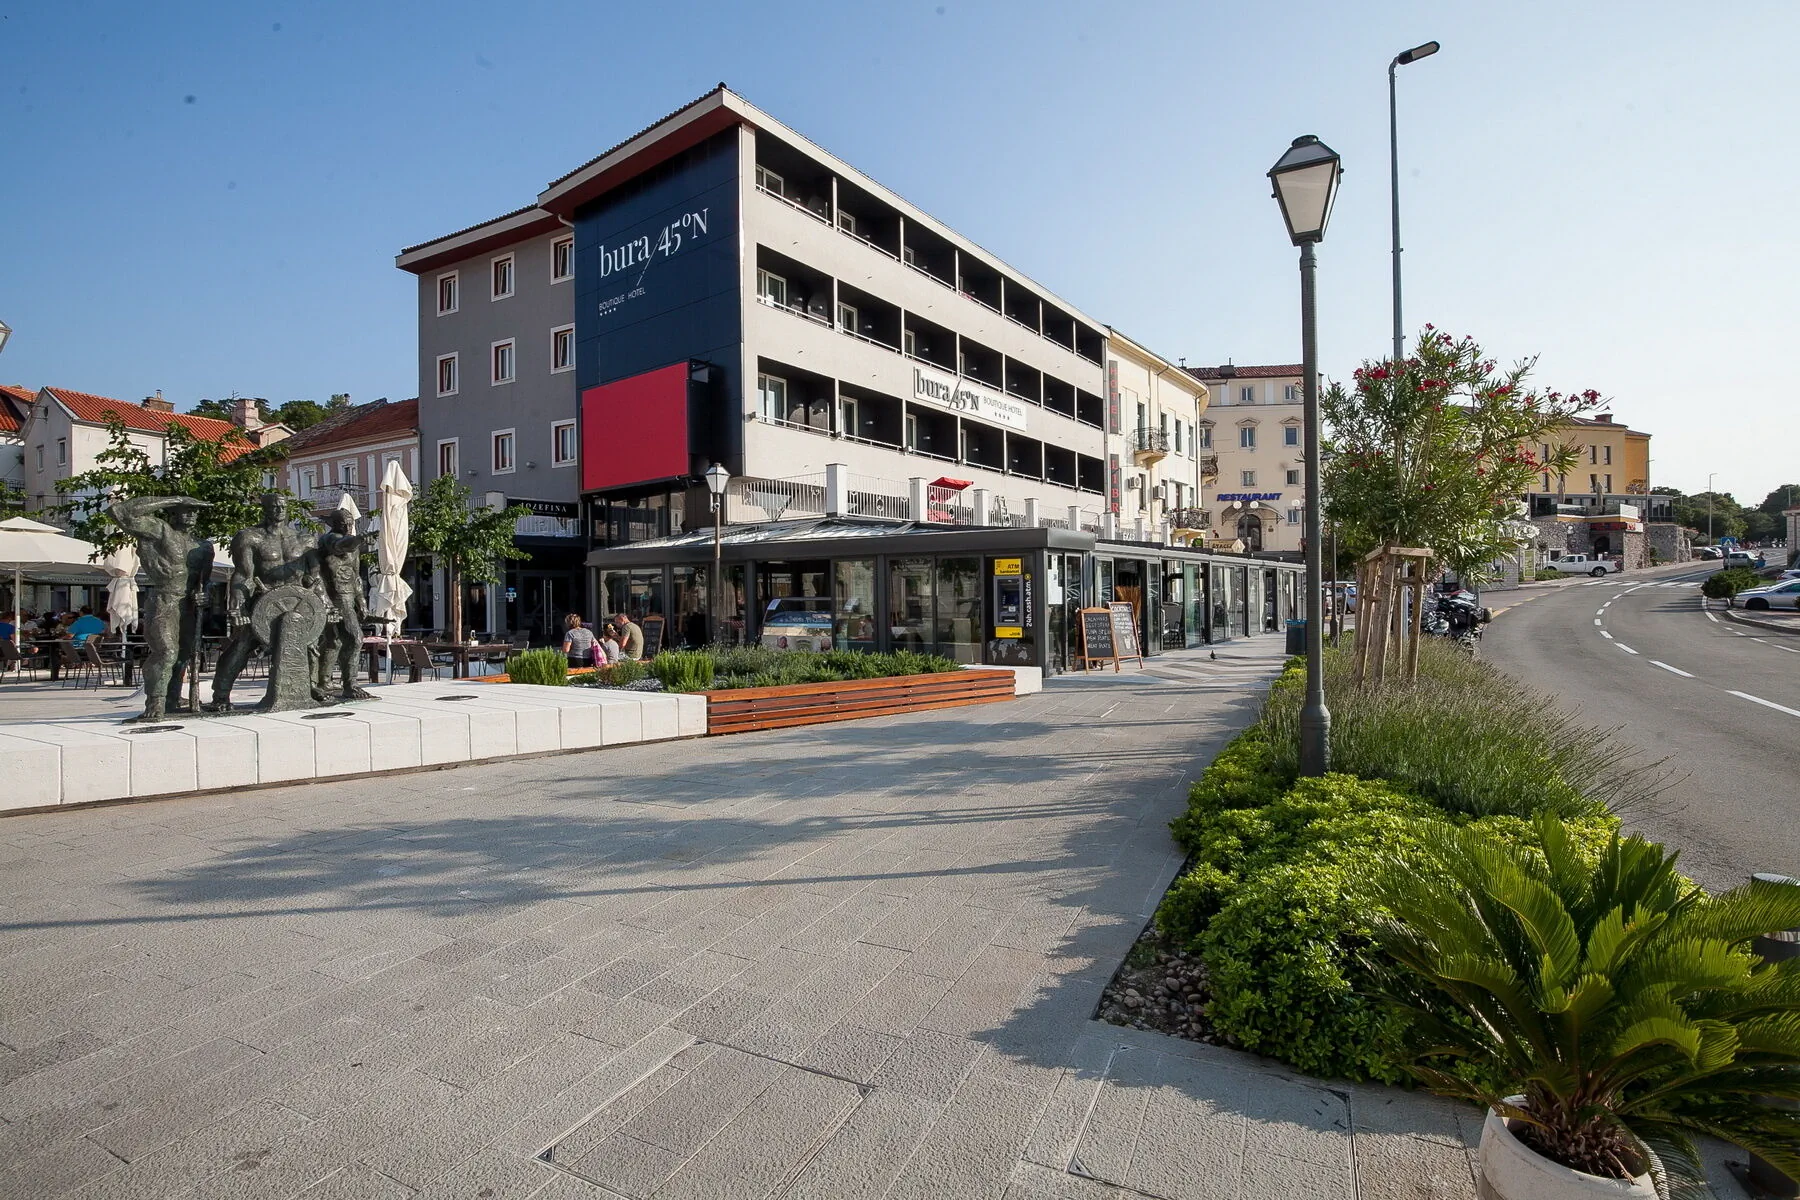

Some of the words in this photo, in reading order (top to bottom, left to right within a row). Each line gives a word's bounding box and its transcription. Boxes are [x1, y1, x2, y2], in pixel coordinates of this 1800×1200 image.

[599, 235, 650, 279] bura
[598, 294, 625, 311] BOUTIQUE
[627, 287, 646, 299] HOTEL
[915, 368, 950, 403] bura
[1110, 367, 1118, 427] HOTEL
[983, 396, 1008, 412] BOUTIQUE
[1008, 403, 1023, 417] HOTEL
[1111, 460, 1119, 513] LIBR
[1217, 493, 1282, 501] RESTAURANT
